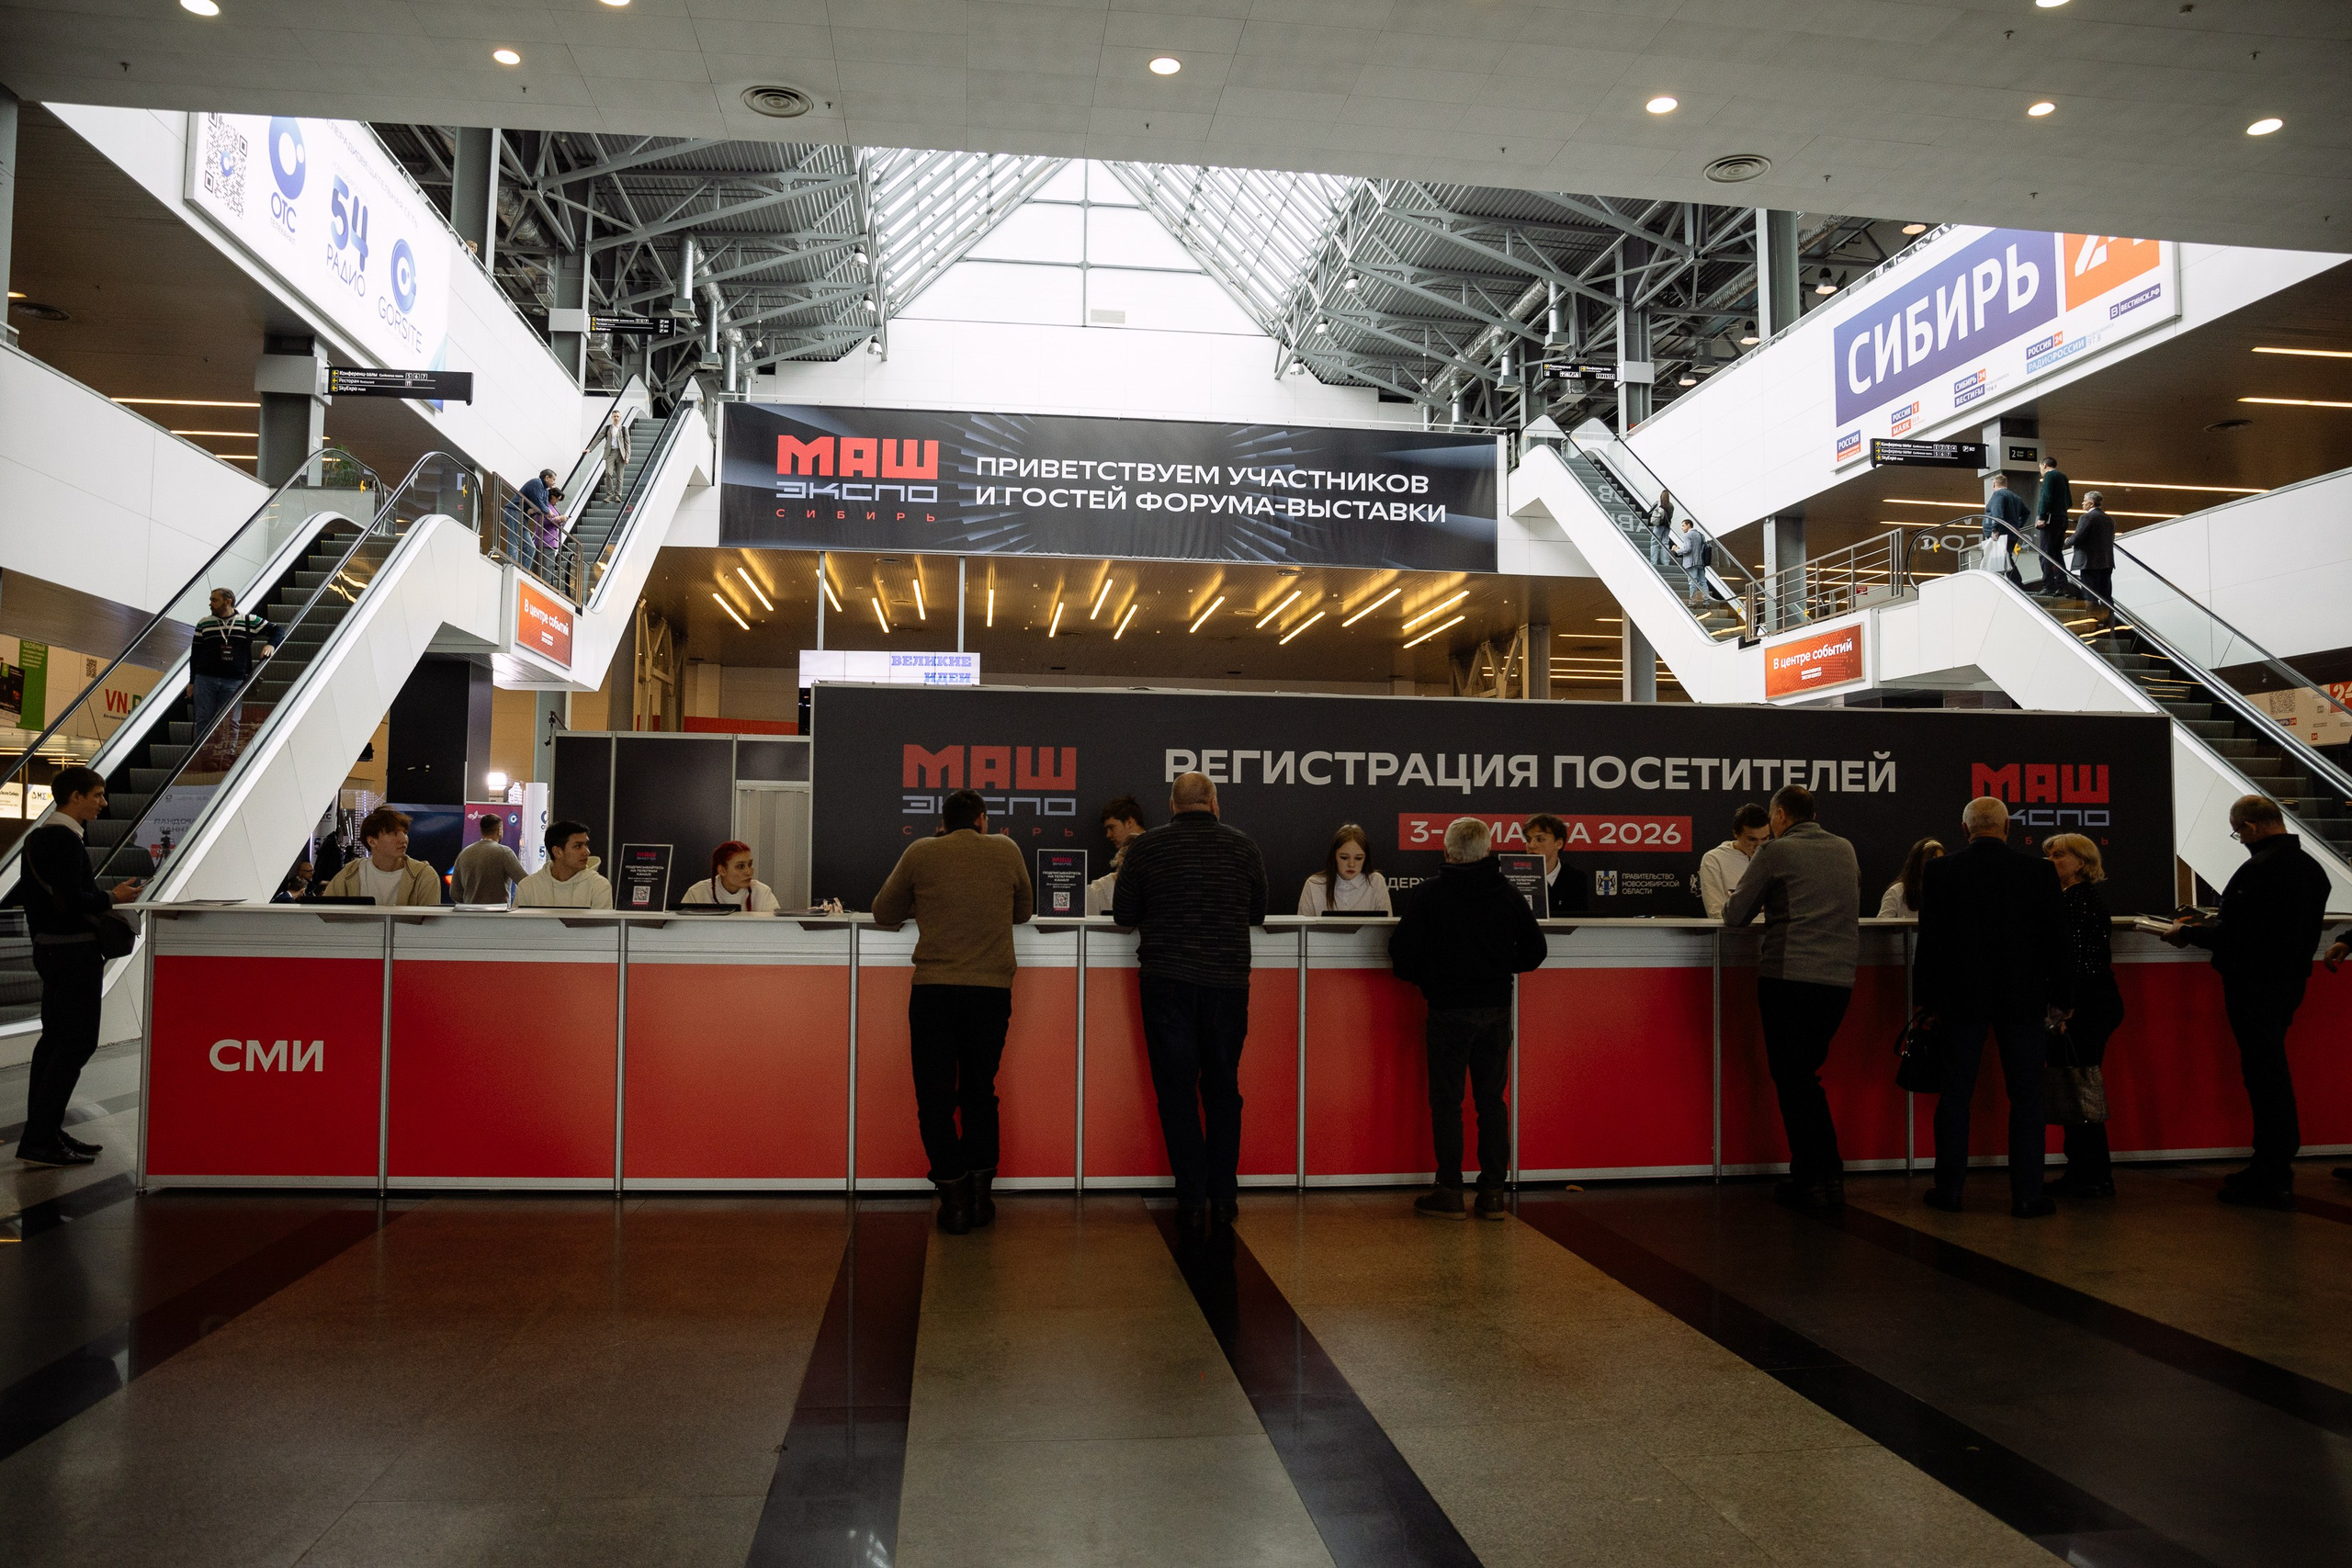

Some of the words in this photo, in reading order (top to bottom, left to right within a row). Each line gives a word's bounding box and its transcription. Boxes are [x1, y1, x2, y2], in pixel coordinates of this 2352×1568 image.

[271, 191, 297, 233] ОТС
[331, 174, 368, 273] 54
[326, 243, 366, 298] РАДИО
[378, 296, 423, 355] GORSITE
[1848, 243, 2040, 395] СИБИРЬ
[2028, 338, 2052, 357] РОССИЯ
[2054, 333, 2063, 344] 24
[2028, 339, 2085, 371] РАДИОРОССИИ
[1955, 376, 1977, 392] СИБИРЬ
[1893, 406, 1911, 423] РОССИЯ
[1893, 420, 1910, 435] МАЯК
[776, 434, 939, 479] МАШ
[1838, 434, 1860, 450] РОССИЯ
[976, 457, 1220, 485] ПРИВЕТСТВУЕМ
[1227, 467, 1429, 493] УЧАСТНИКОВ
[776, 481, 938, 503] ЭКСПО
[976, 486, 996, 505] И
[1005, 485, 1126, 510] ГОСТЕЙ
[1136, 491, 1446, 523] ФОРУМА-ВЫСТАВКИ
[775, 509, 935, 523] СИБИРЬ
[525, 598, 529, 613] В
[530, 604, 548, 625] центре
[549, 615, 569, 637] событий
[891, 655, 972, 667] ВЕЛИКИЕ
[1773, 658, 1780, 670] В
[1781, 652, 1811, 669] центре
[1812, 638, 1853, 660] событий
[923, 672, 971, 685] ИДЕИ
[902, 744, 1077, 791] МАШ
[1165, 748, 1538, 795] РЕГИСТРАЦИЯ
[1554, 750, 1896, 793] ПОСЕТИТЕЛЕЙ
[1972, 762, 2109, 804] МАШ
[902, 795, 1076, 816] ЭСПО
[2008, 809, 2109, 827] КСПО
[1600, 822, 1681, 845] 2026
[1622, 879, 1679, 887] НОВОСИБИРСКОЙ
[209, 1038, 324, 1072] СМИ
